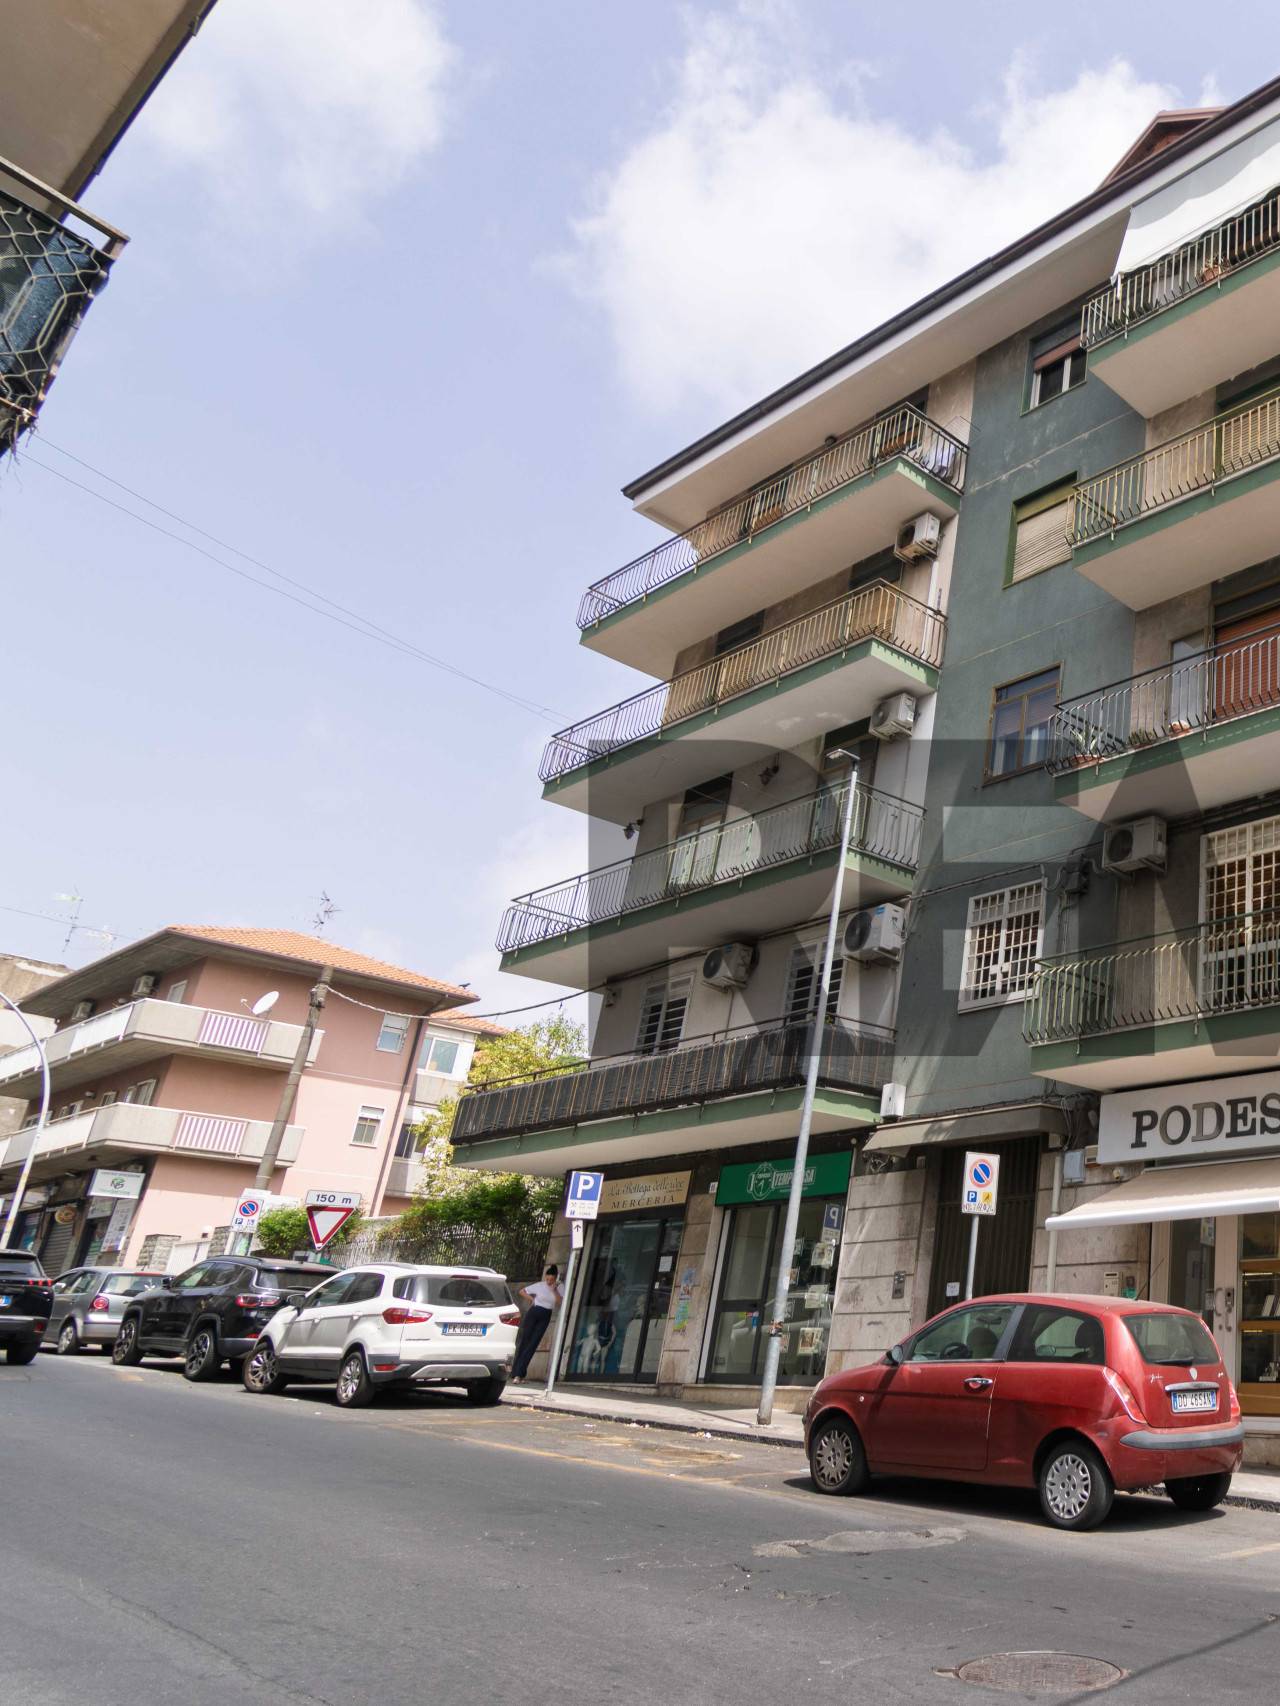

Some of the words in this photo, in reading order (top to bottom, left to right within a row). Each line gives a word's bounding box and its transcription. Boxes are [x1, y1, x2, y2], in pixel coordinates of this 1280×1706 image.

[577, 1175, 595, 1199] P
[316, 1193, 336, 1203] 150
[611, 1195, 675, 1209] MERCERIA
